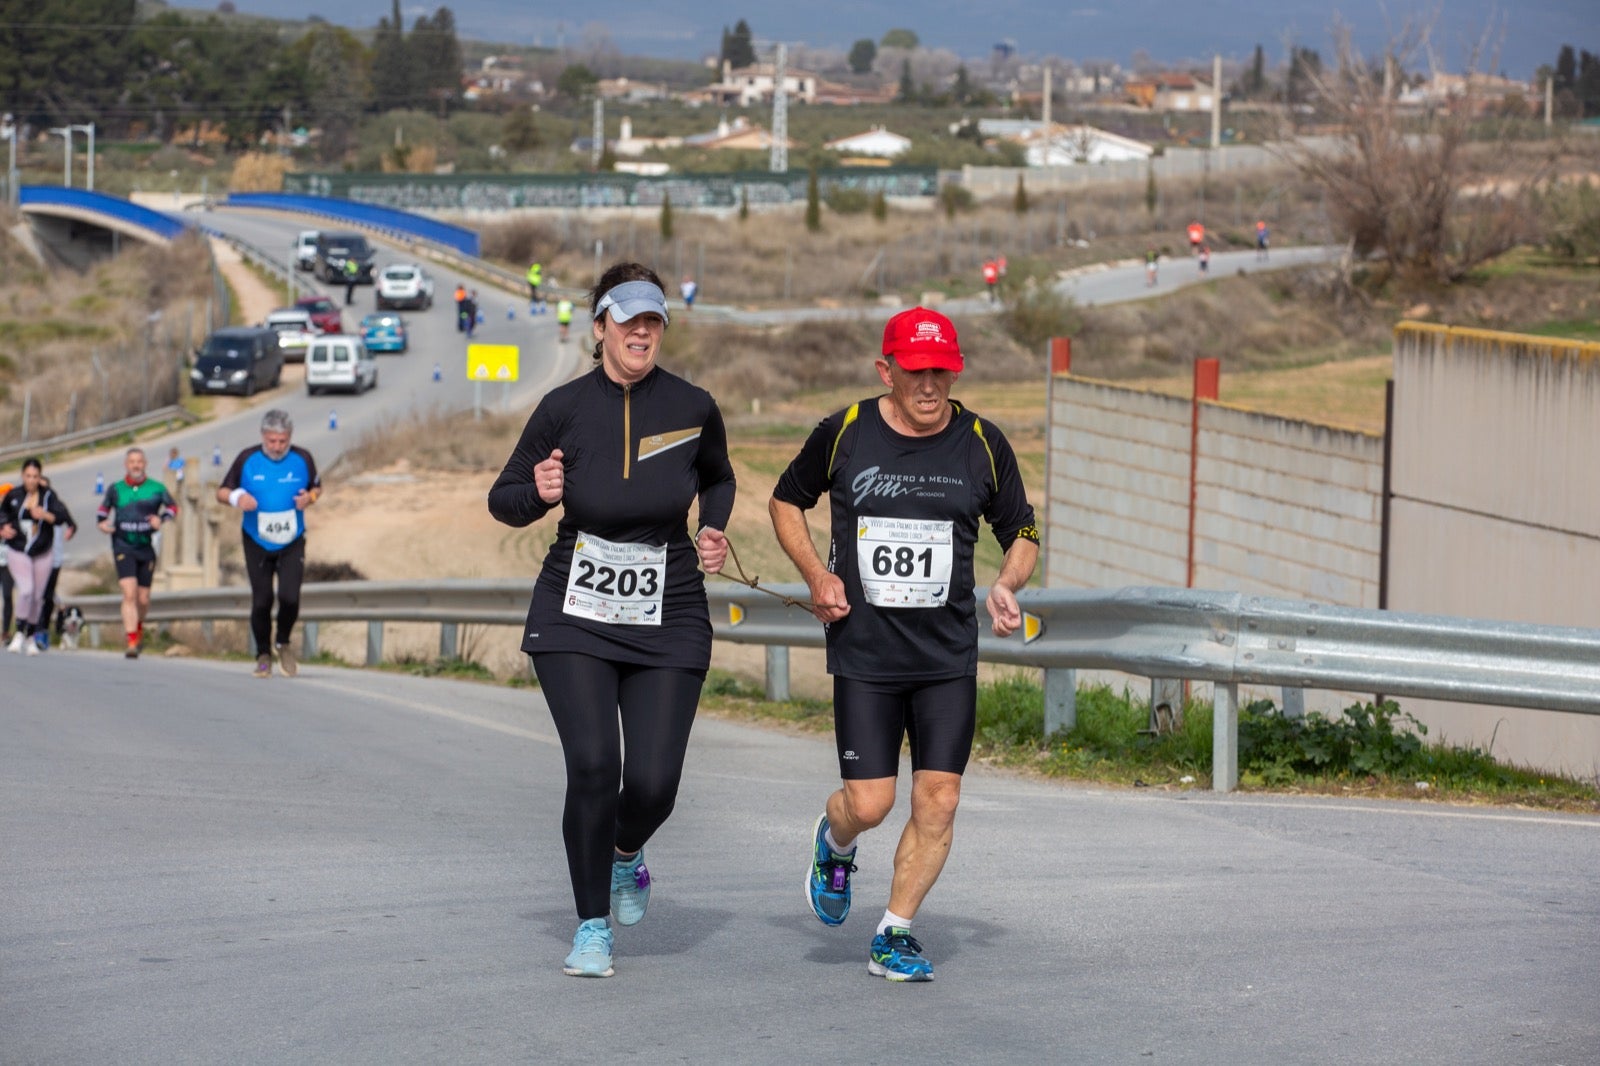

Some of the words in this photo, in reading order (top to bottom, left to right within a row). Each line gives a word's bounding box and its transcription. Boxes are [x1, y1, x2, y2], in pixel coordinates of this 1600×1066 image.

[929, 475, 964, 486] MEDINA
[266, 521, 290, 533] 494
[872, 545, 933, 578] 681
[574, 560, 658, 597] 2203
